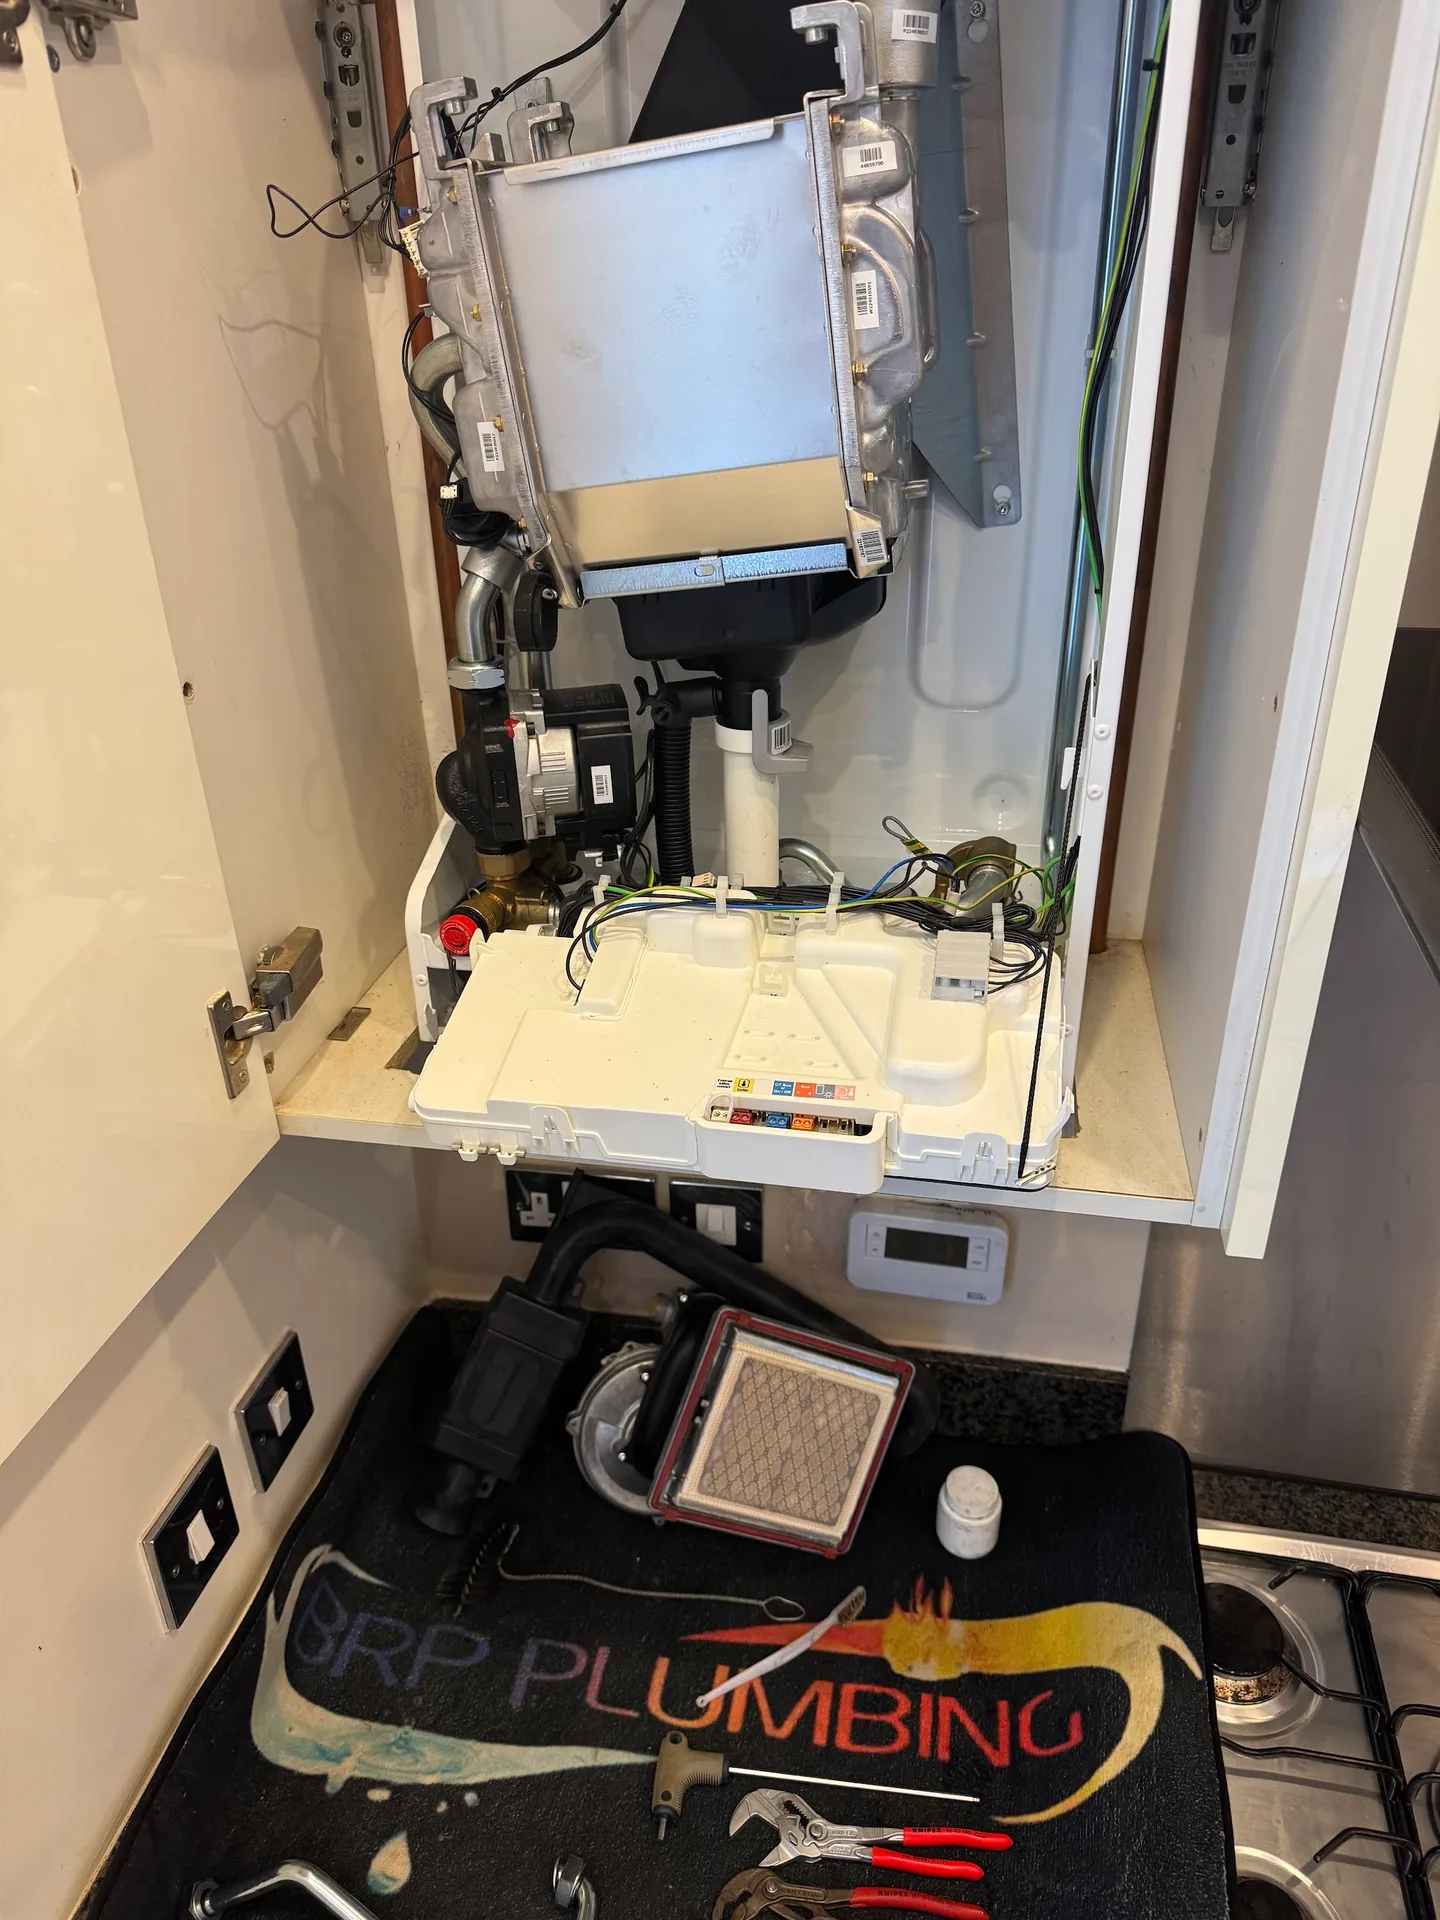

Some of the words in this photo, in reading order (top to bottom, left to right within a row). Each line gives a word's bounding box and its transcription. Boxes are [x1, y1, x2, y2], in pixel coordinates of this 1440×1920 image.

[510, 1638, 1084, 1768] PLUMBING
[912, 1826, 941, 1834] KNIPEX
[877, 1889, 909, 1898] KNIPEX
